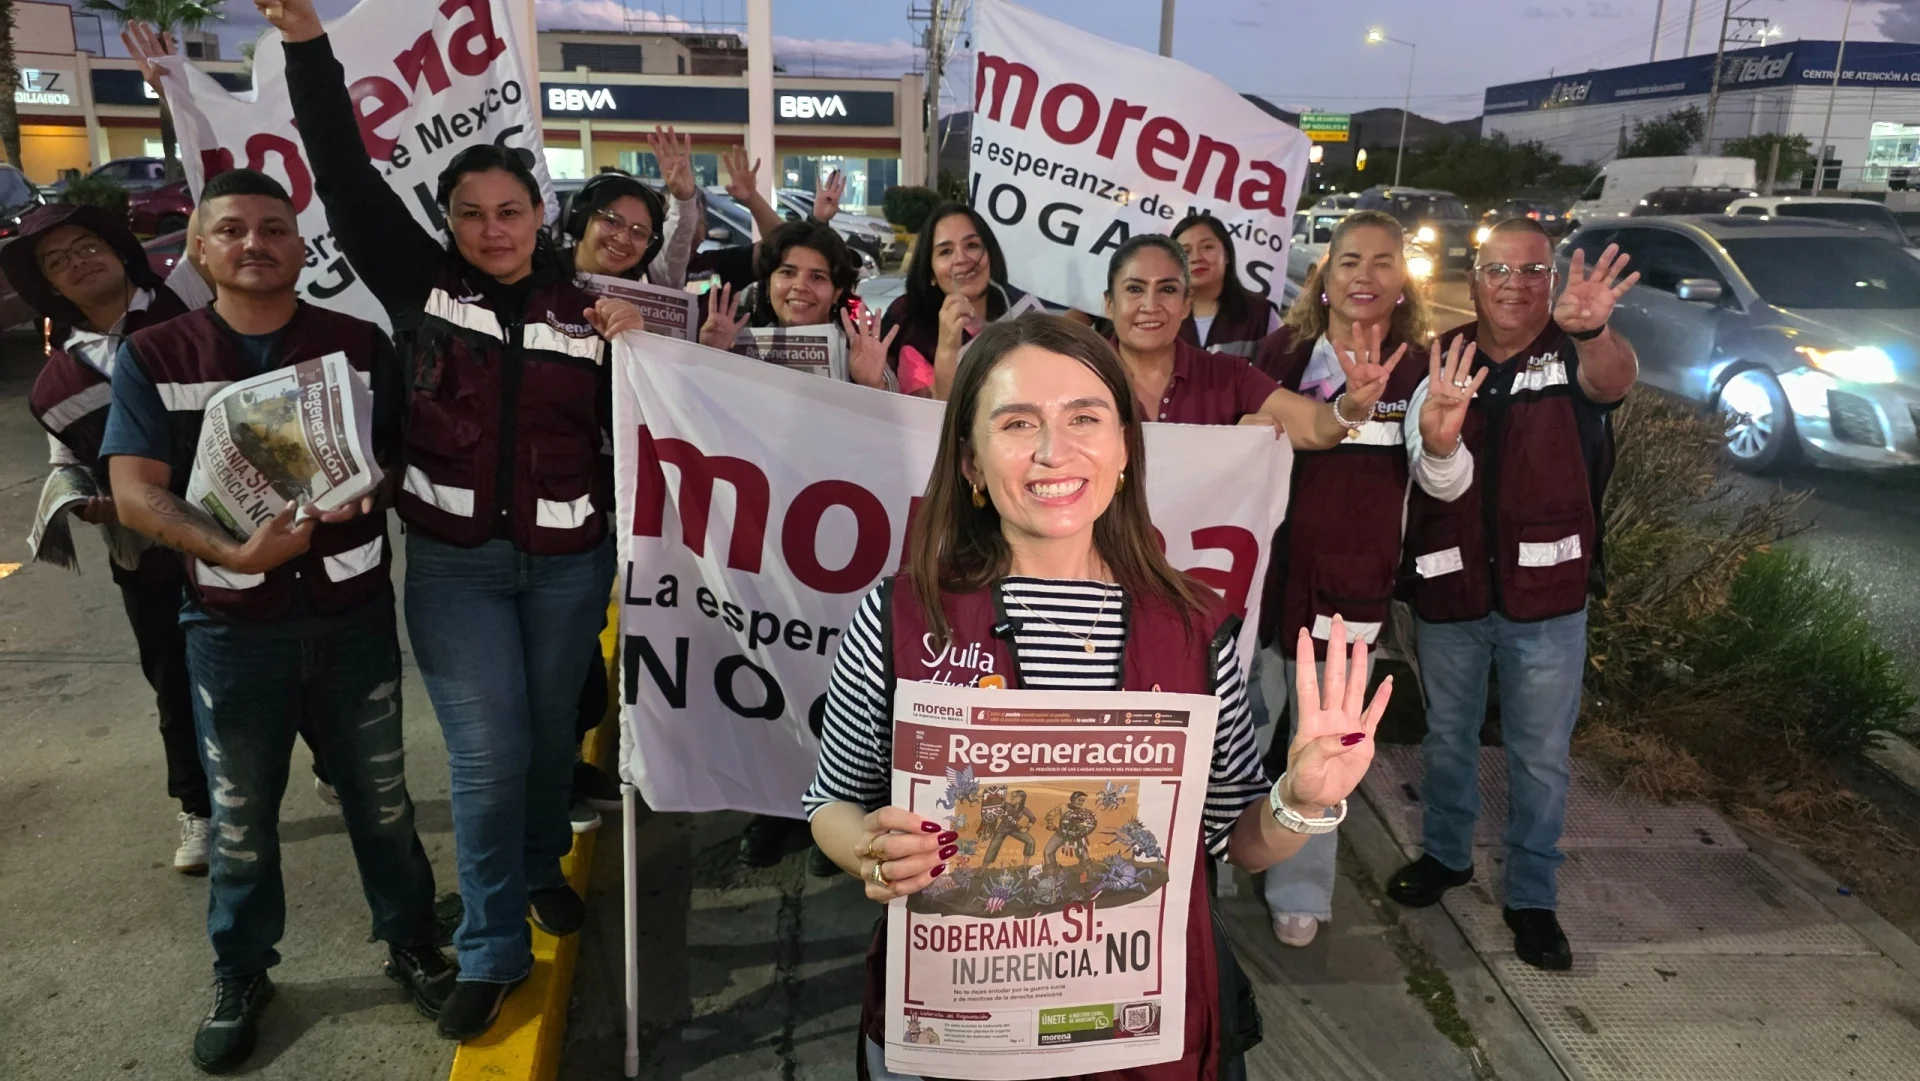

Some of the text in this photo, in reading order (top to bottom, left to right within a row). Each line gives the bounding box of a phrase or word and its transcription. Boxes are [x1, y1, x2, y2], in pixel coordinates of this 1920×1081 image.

[1842, 71, 1854, 80] DE
[1855, 70, 1901, 81] ATENCIÓN
[1901, 73, 1909, 82] A
[200, 0, 507, 216] oena
[548, 88, 616, 111] BBVA
[780, 94, 847, 119] BBVA
[974, 51, 1287, 217] morena
[987, 140, 1131, 207] esperanza
[1139, 193, 1175, 221] de
[1186, 206, 1283, 253] Mxico
[303, 381, 344, 481] Regeneración
[625, 560, 679, 609] La
[913, 702, 963, 717] morena
[948, 734, 1176, 773] Regeneración
[913, 912, 1059, 952] SOBERANÍA,
[952, 930, 1150, 985] INJERENCIA, NO
[971, 988, 987, 996] dejes
[1030, 985, 1049, 993] guerra
[1041, 1013, 1066, 1025] ÚNETE
[1041, 1033, 1071, 1041] morena
